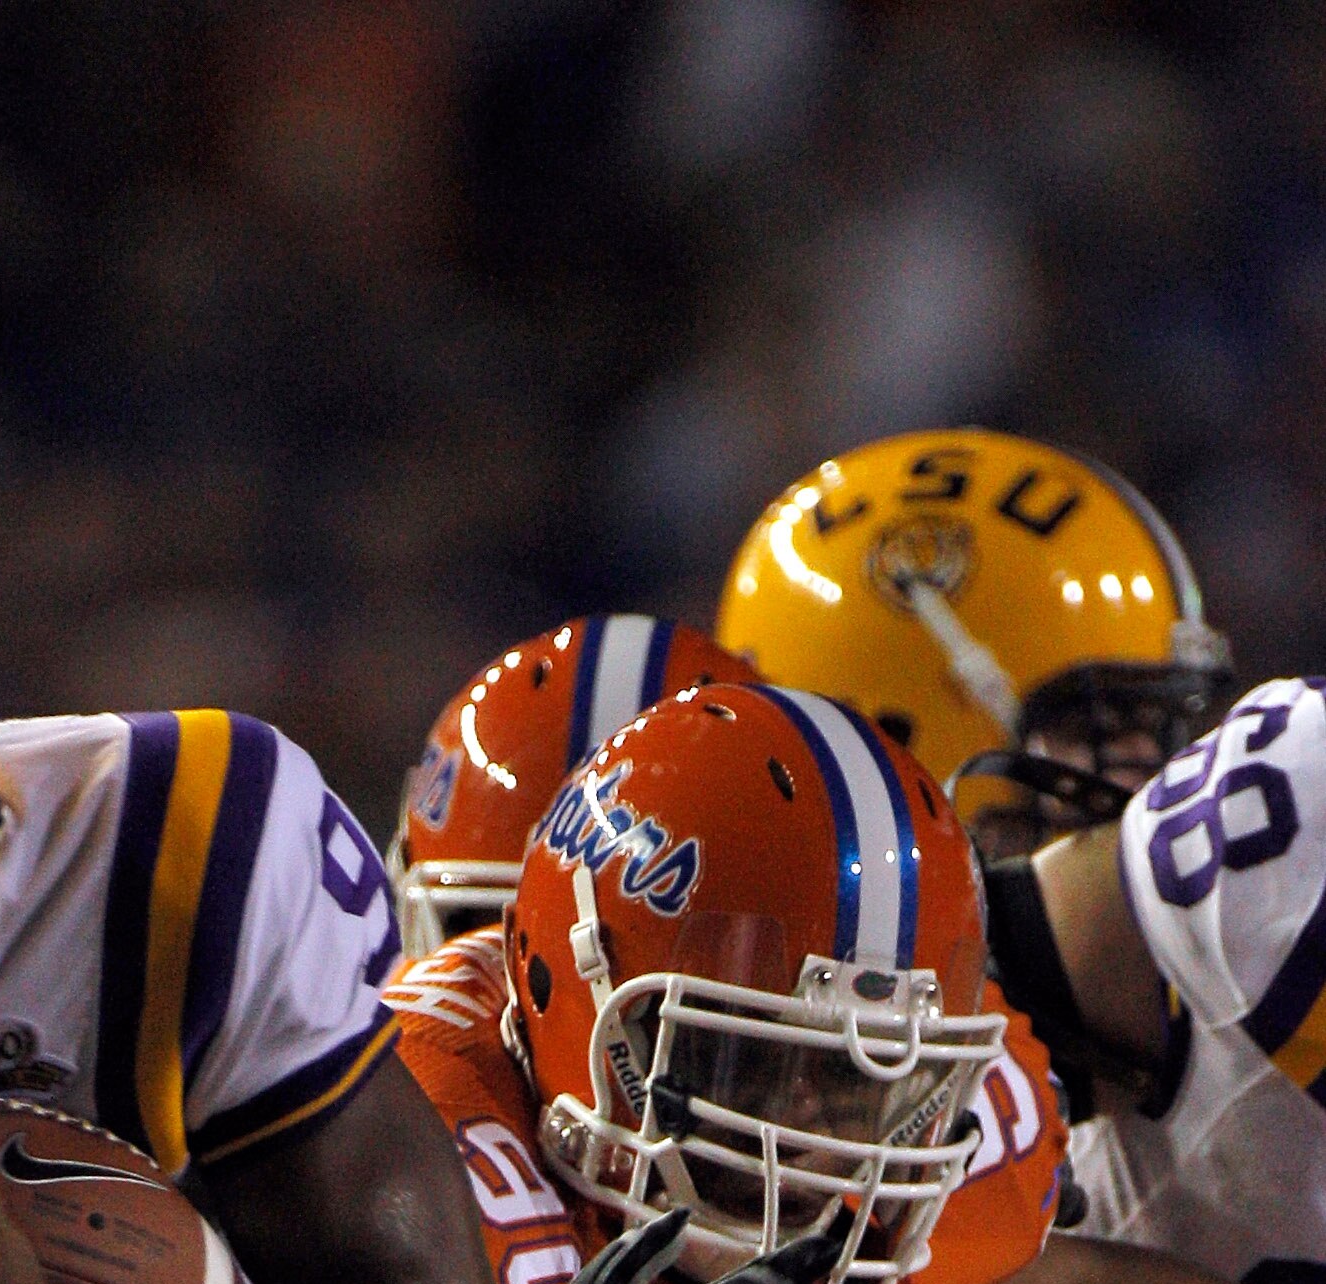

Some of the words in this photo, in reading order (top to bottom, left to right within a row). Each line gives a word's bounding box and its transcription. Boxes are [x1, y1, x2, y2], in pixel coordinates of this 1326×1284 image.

[815, 448, 1079, 535] LSU
[318, 790, 402, 988] 9
[530, 760, 705, 917] ators
[608, 1040, 648, 1115] Ridde
